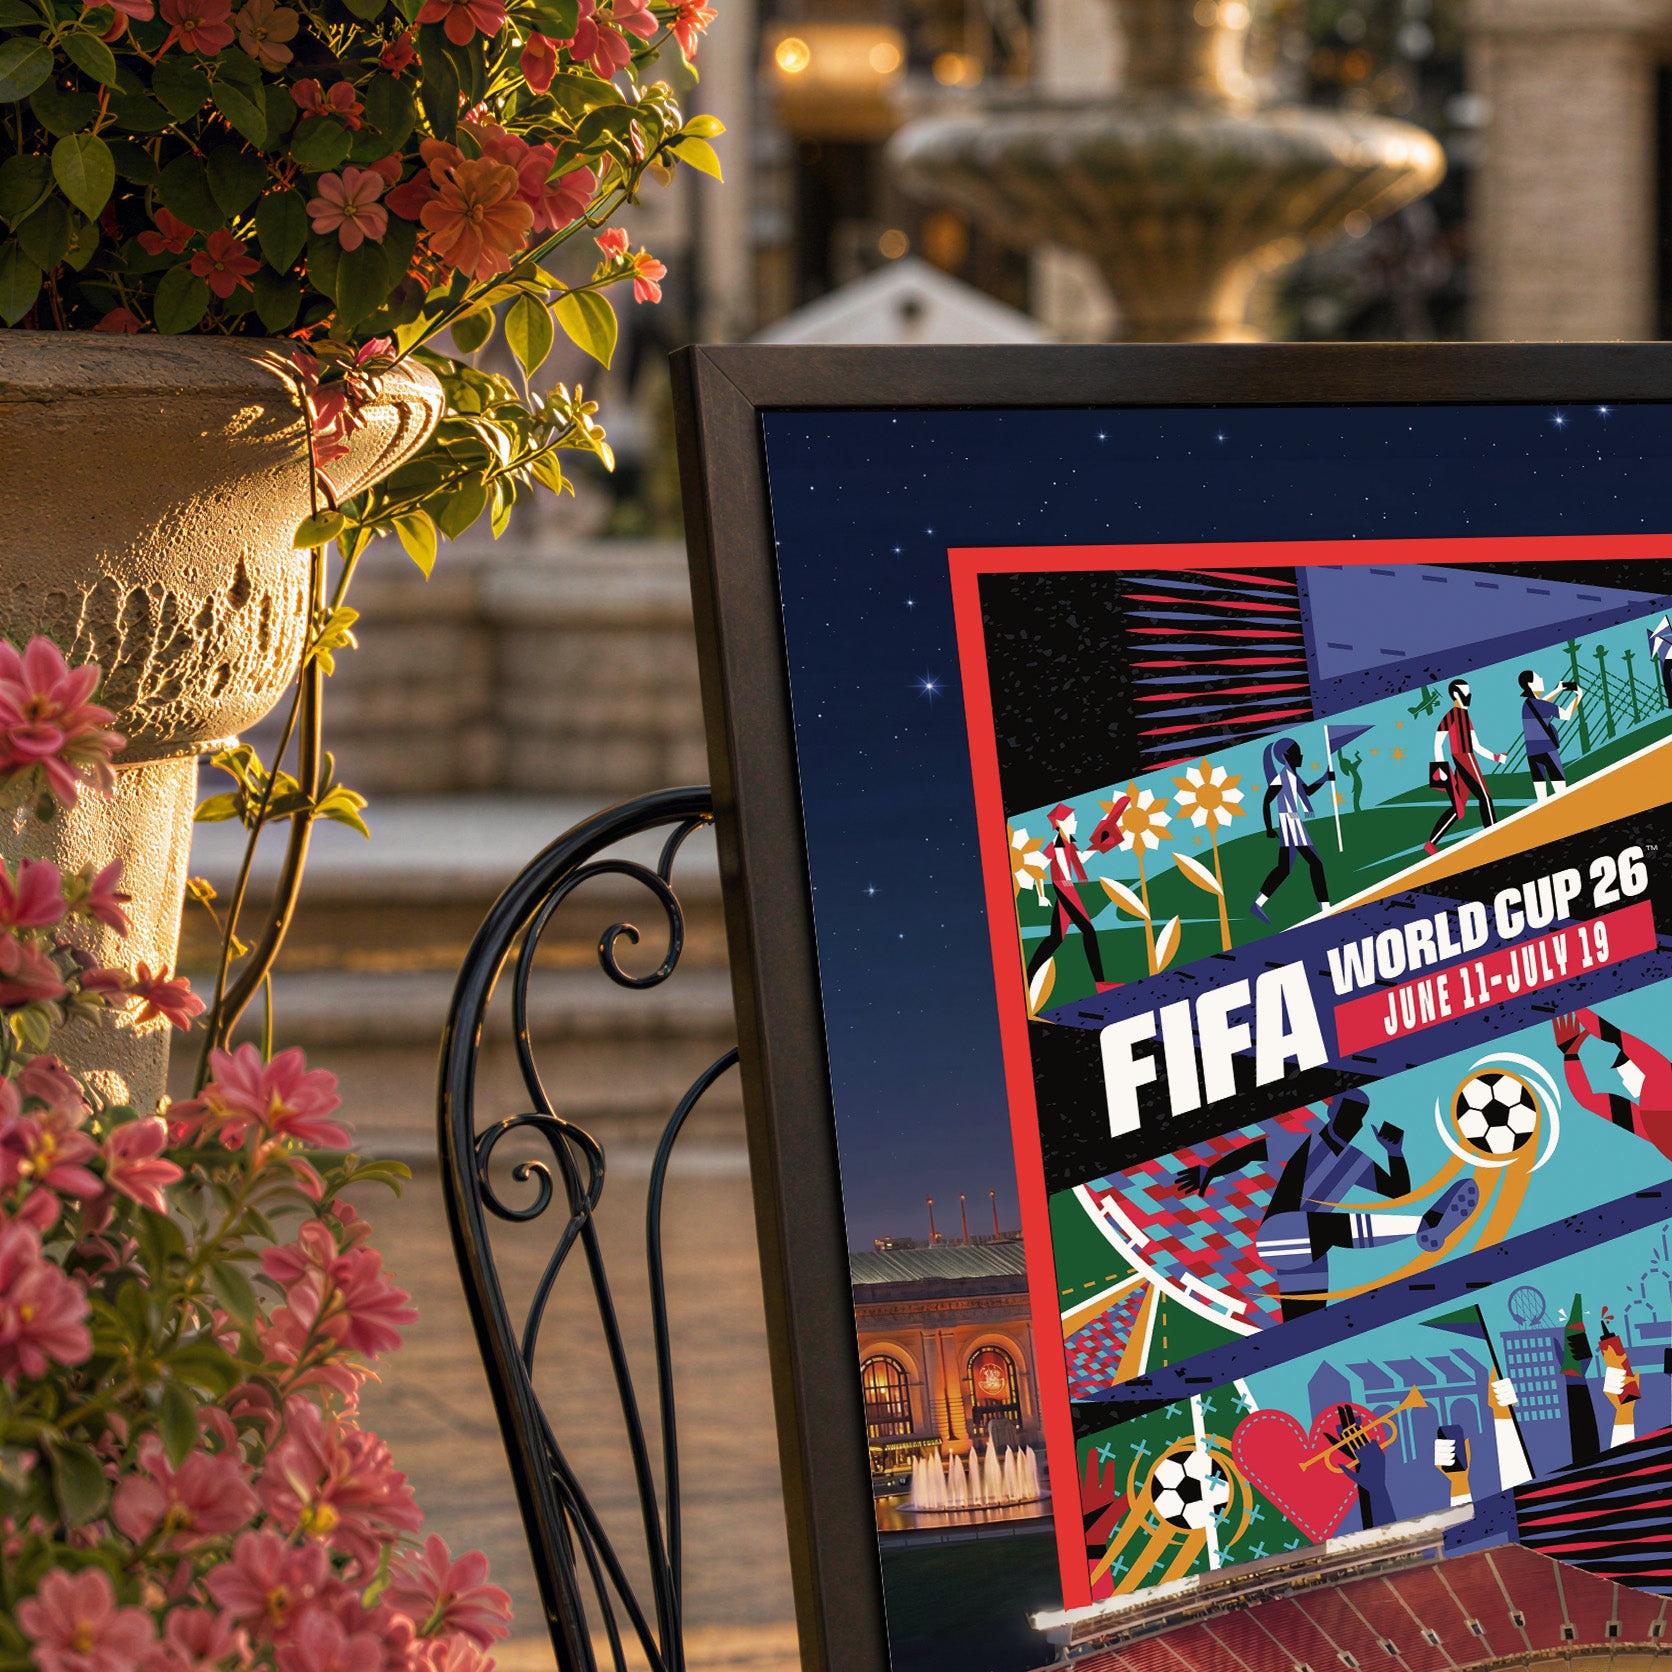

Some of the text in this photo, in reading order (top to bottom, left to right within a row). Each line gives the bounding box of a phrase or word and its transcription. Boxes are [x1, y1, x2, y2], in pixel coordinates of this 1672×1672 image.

[1326, 901, 1489, 996] WORLD
[1494, 868, 1582, 939] CUP
[1383, 920, 1610, 1036] JUNE 11-JULY 19
[1099, 960, 1329, 1138] FIFA
